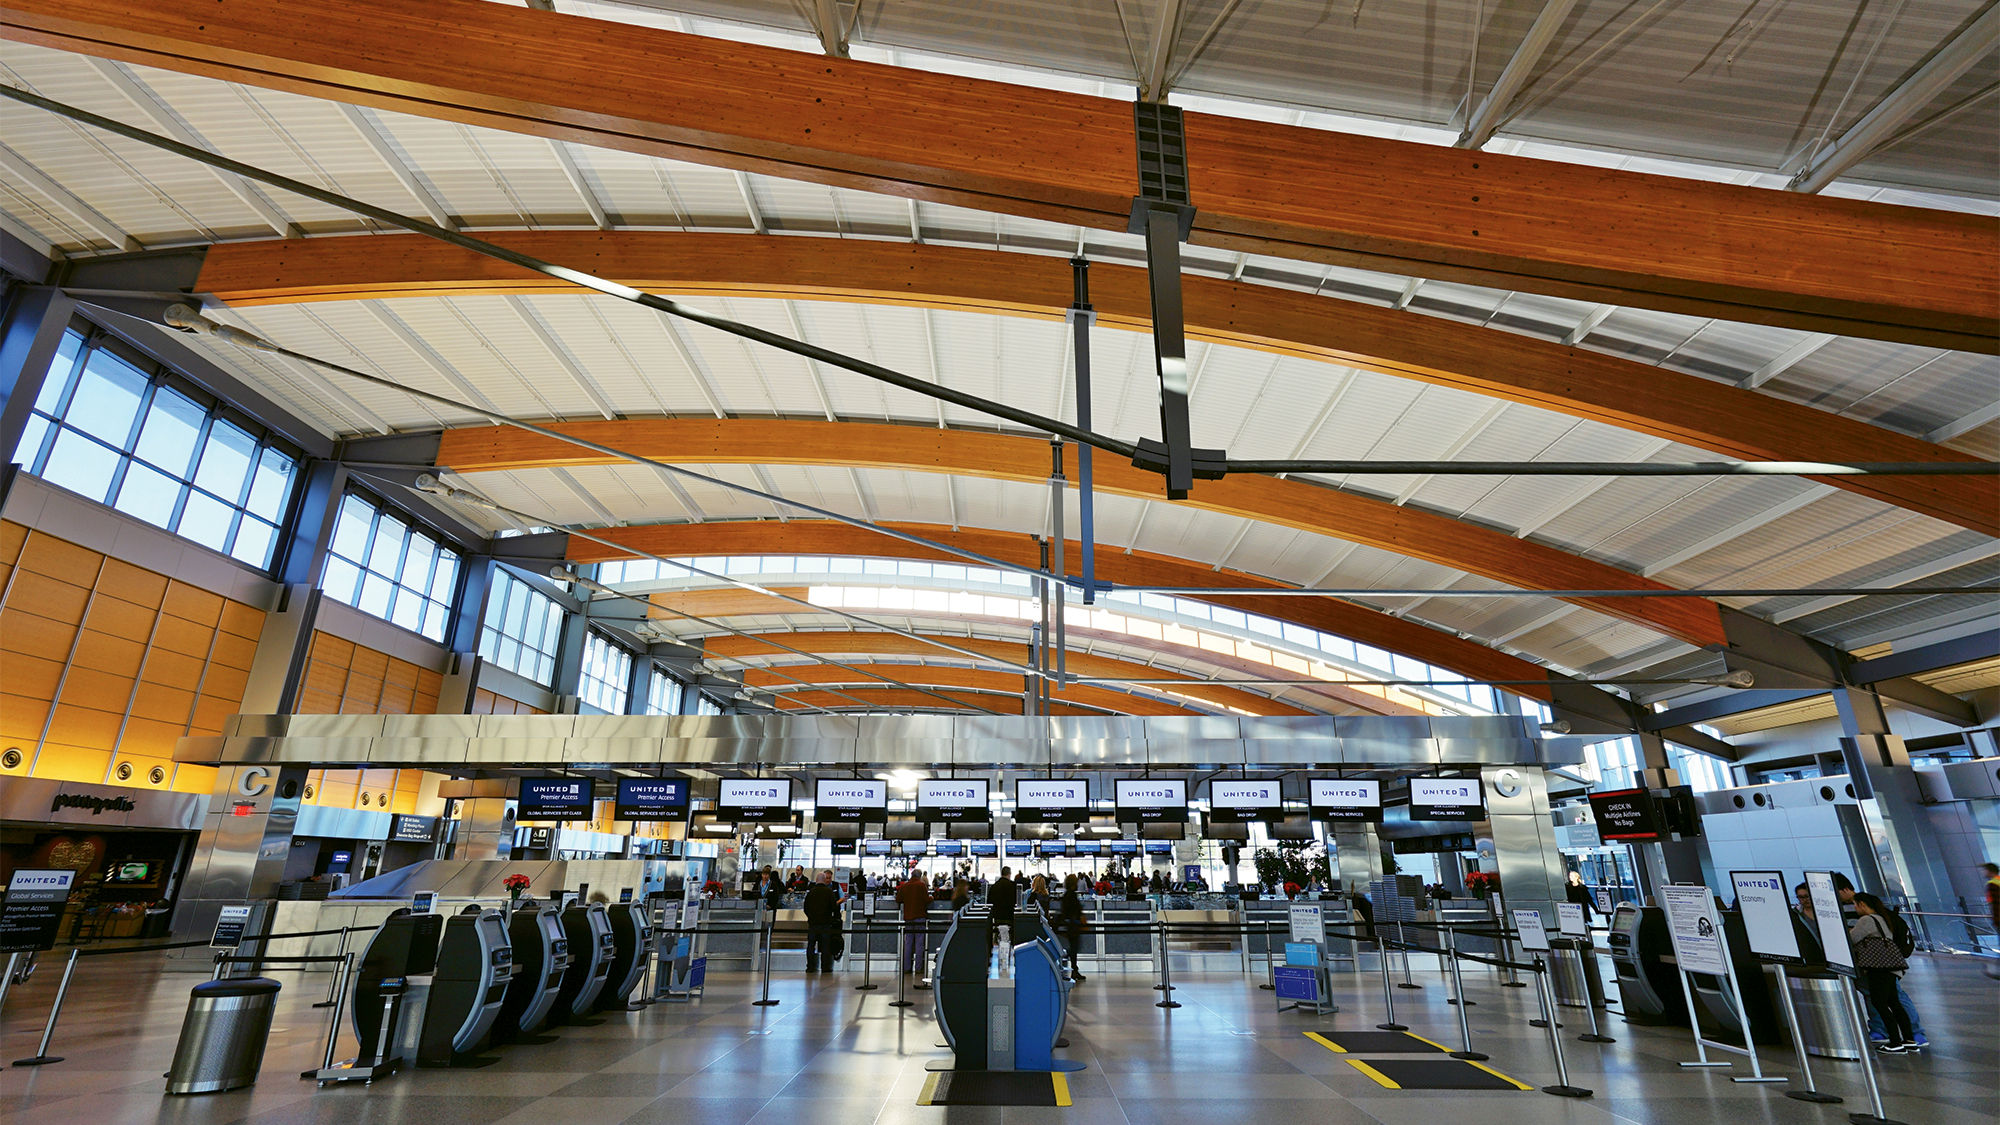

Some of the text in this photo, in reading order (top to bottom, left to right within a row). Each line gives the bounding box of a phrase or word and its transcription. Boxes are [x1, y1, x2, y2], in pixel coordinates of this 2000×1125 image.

[238, 767, 268, 796] C
[1494, 768, 1522, 798] C
[1741, 895, 1765, 903] Economy
